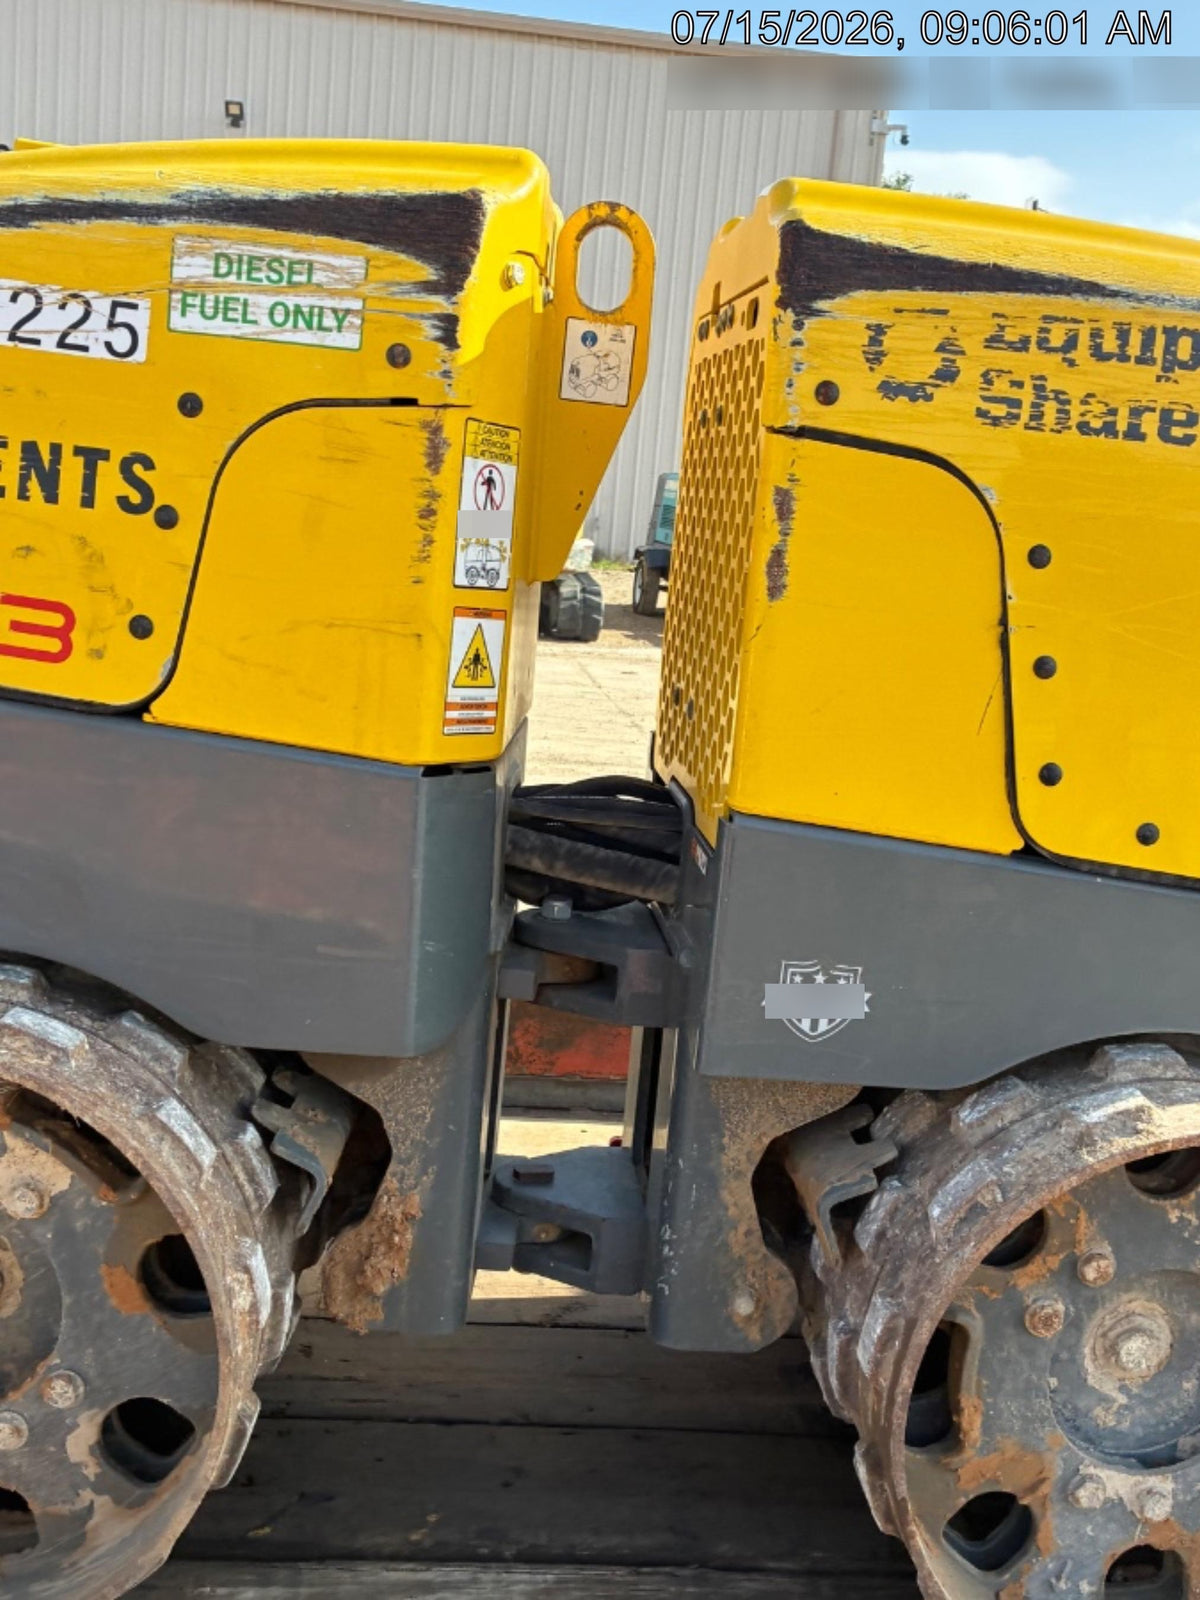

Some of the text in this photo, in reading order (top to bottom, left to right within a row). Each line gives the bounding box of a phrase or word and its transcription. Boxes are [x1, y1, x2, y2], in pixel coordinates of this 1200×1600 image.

[213, 251, 323, 288] DIESEL
[180, 291, 350, 333] FUEL ONLY
[975, 368, 1200, 446] Share
